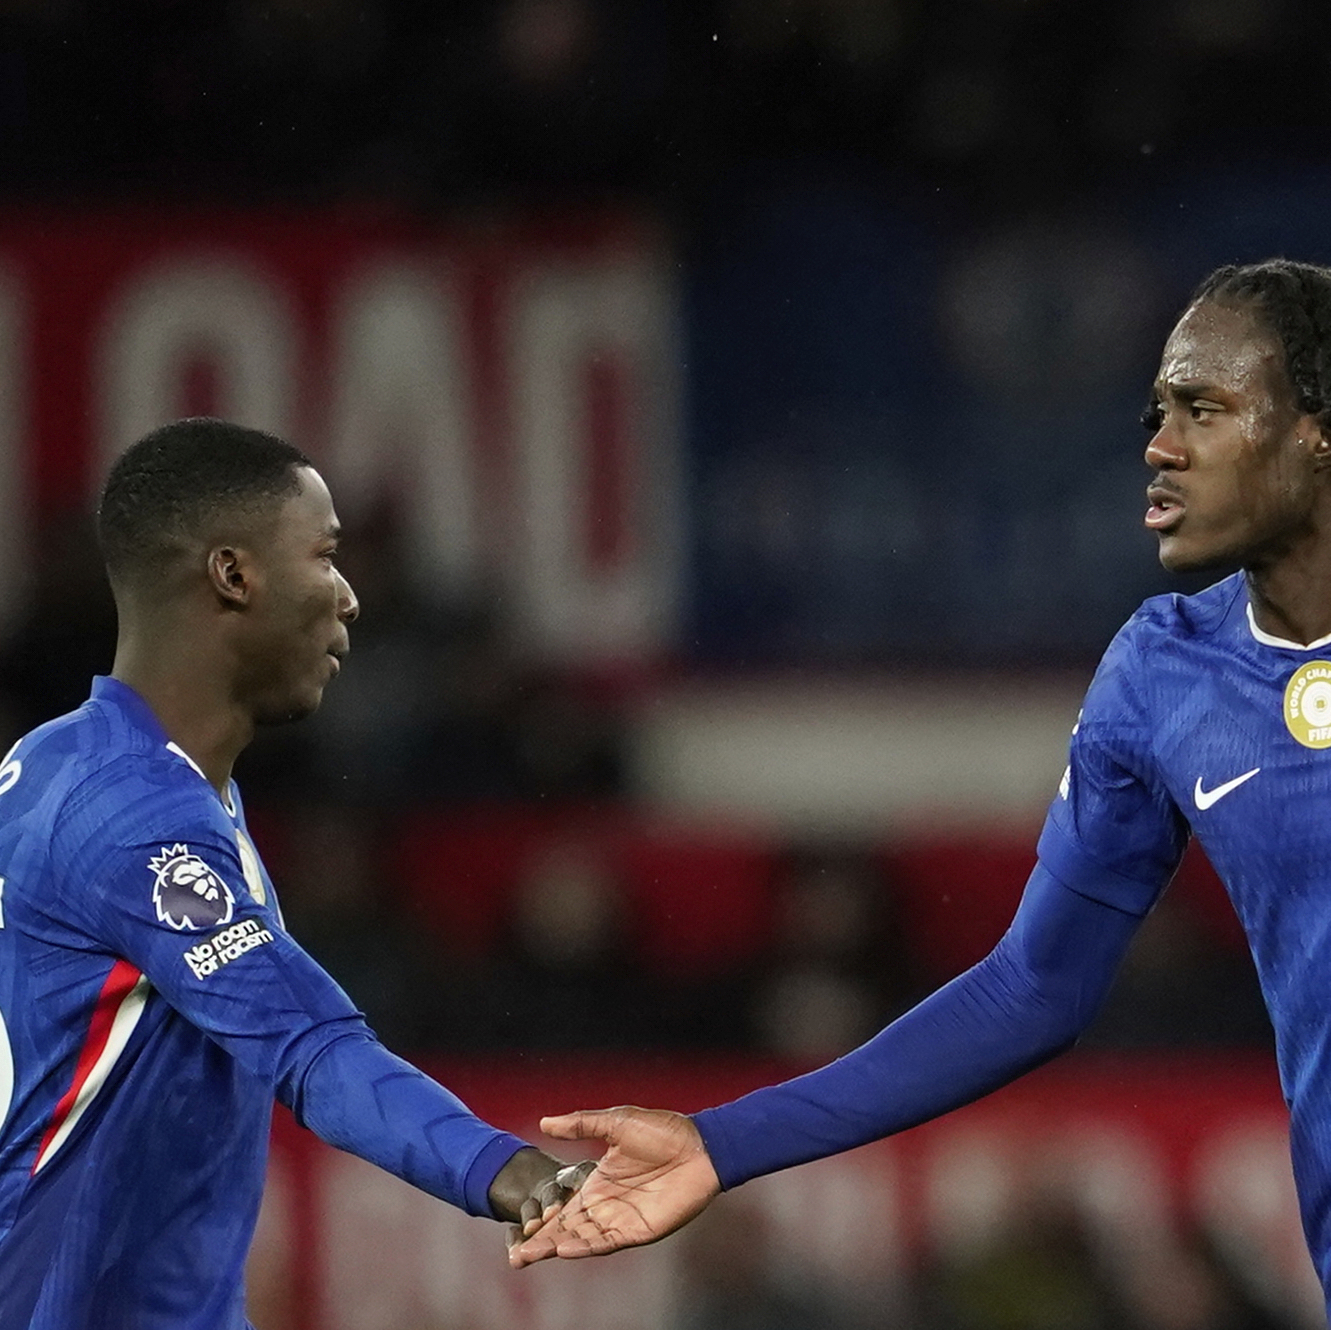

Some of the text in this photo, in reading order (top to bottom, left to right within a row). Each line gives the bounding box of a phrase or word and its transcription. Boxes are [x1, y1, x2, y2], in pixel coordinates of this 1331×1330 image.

[1290, 677, 1307, 719] WORLD
[183, 919, 260, 970] No room
[191, 929, 275, 981] for racism
